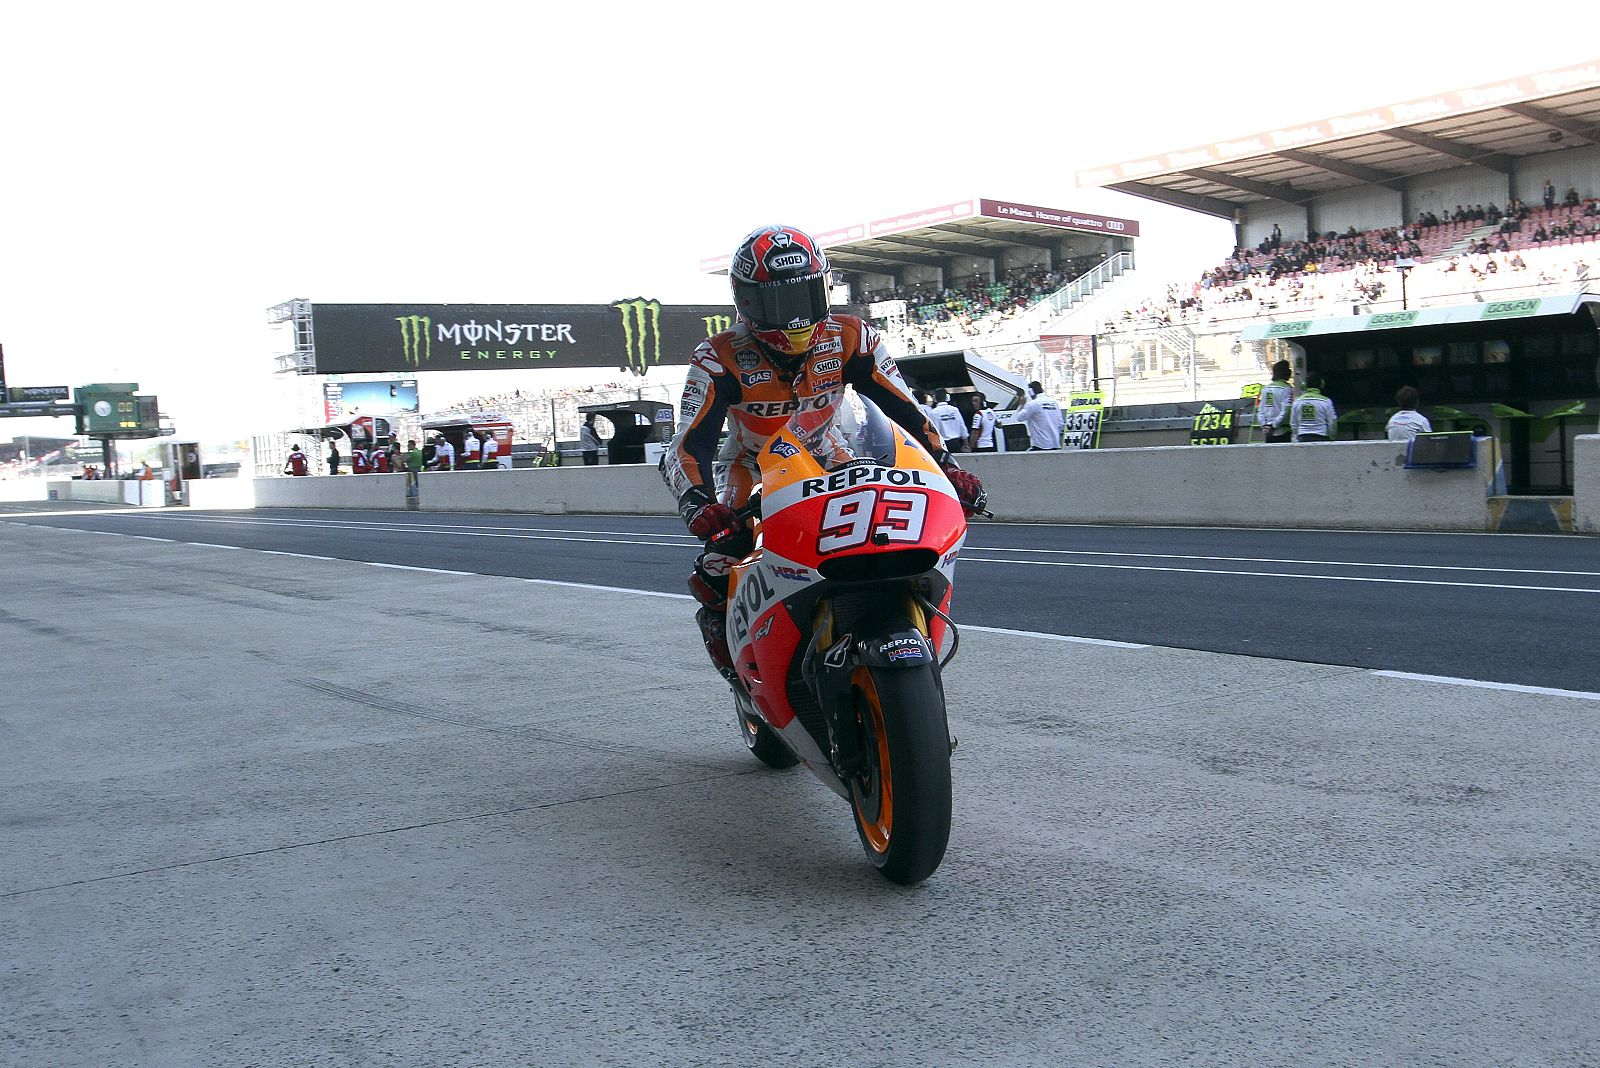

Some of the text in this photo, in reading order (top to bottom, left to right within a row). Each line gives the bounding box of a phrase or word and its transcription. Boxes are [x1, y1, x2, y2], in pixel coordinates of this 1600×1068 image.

[997, 205, 1009, 215] Le
[1036, 211, 1061, 222] Home
[1061, 215, 1072, 223] of
[1072, 216, 1103, 228] quattro
[774, 255, 803, 268] SHOEI
[1486, 300, 1537, 315] GO&FUN
[787, 319, 811, 330] LOTUS
[1370, 311, 1416, 325] GO&FUN
[436, 319, 577, 347] MONSTER
[814, 340, 841, 352] REPSOL
[460, 350, 557, 361] ENERGY
[816, 359, 840, 373] SHOEI
[748, 372, 771, 384] GAS
[1193, 413, 1232, 431] 1234
[774, 443, 795, 457] GAS
[846, 459, 877, 468] HONDA
[802, 467, 926, 498] REPSOL
[816, 486, 929, 556] 93
[766, 563, 811, 582] HRC
[879, 638, 923, 653] REPSOL
[888, 648, 923, 662] HRC
